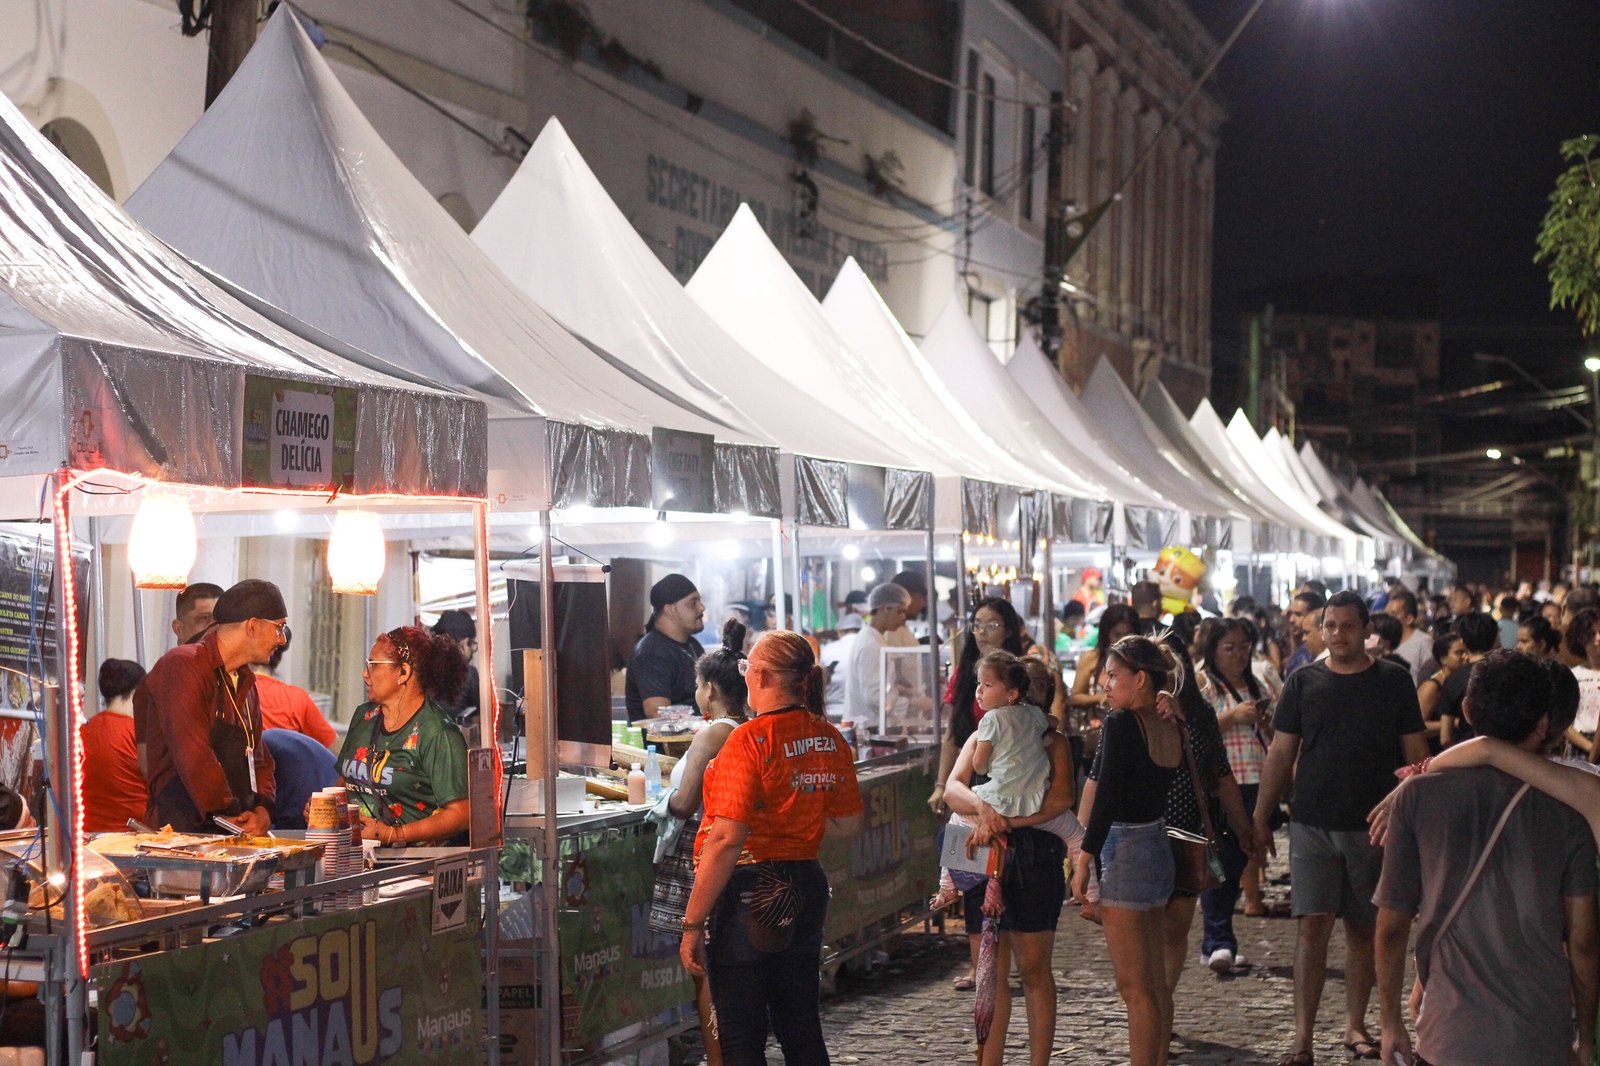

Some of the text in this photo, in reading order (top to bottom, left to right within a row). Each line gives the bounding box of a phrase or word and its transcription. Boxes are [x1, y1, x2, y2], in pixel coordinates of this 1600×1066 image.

[275, 409, 330, 440] CHAMEGO
[281, 438, 322, 473] DELÍCIA
[438, 867, 464, 899] CAIXA
[573, 945, 620, 974] Manaus
[640, 967, 673, 989] PASSO
[417, 1007, 472, 1041] Manaus
